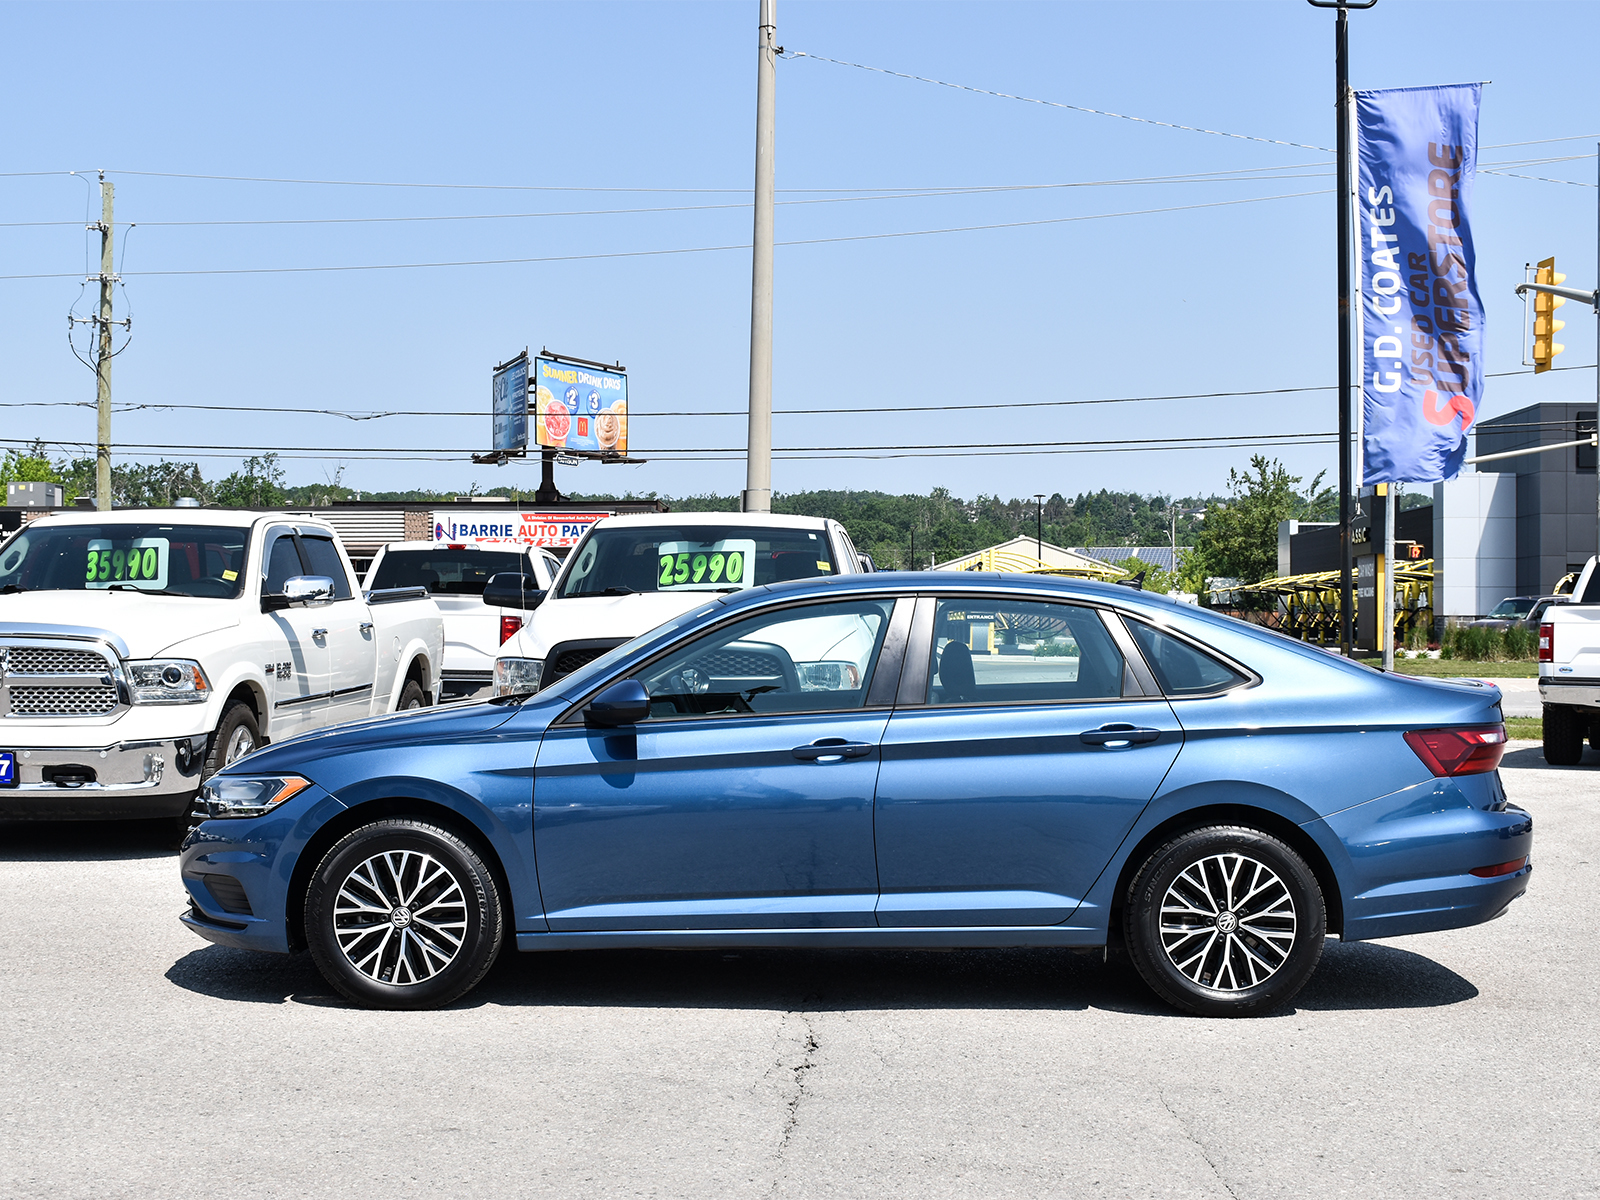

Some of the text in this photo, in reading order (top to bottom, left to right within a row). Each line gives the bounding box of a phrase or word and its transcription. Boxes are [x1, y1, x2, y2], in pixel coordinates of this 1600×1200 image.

[1368, 184, 1402, 394] G.D. COATES
[1422, 141, 1475, 431] SUPERSTORE
[1407, 251, 1434, 386] USED CAR
[542, 365, 578, 384] SUMMER
[578, 372, 602, 389] DRINK
[603, 377, 621, 390] DAYS
[459, 524, 513, 537] BARRIE
[518, 524, 558, 537] AUTO
[85, 547, 157, 581] 35990
[659, 551, 743, 585] 25990
